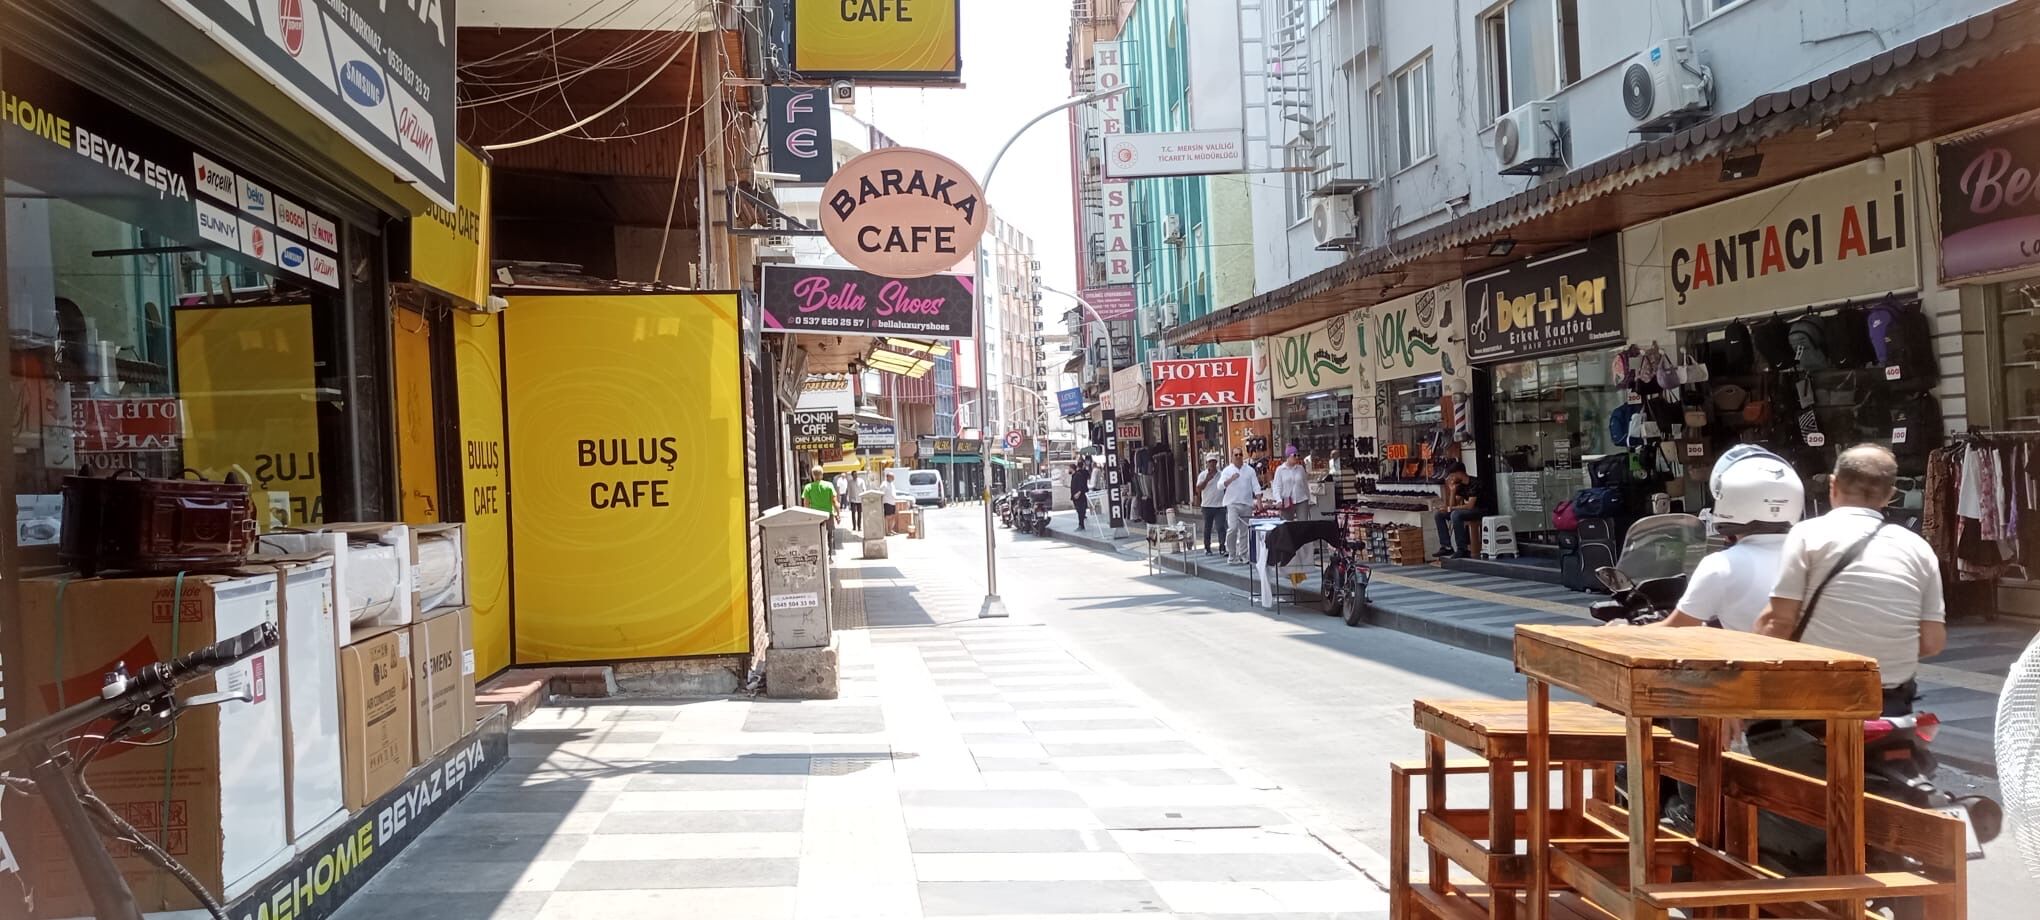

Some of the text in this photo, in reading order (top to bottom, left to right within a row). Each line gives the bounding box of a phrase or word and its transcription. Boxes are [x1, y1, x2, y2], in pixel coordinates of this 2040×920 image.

[841, 0, 913, 22] CAFE
[350, 8, 382, 55] KORKMAZ
[387, 48, 403, 75] 0533
[403, 64, 414, 86] 037
[415, 76, 423, 96] 33
[423, 84, 430, 102] 27
[346, 61, 381, 105] SAMSUNG
[1, 90, 189, 202] HOME BEYAZ EŞYA
[399, 107, 433, 163] arzum
[1177, 144, 1203, 152] MERSİN
[1206, 142, 1234, 151] VALİLİĞİ
[1158, 151, 1239, 162] TİCARET İL MÜDÜRLÜĞÜ
[206, 171, 233, 195] arçelik
[246, 183, 264, 206] beko
[829, 169, 978, 225] BARAKA
[200, 213, 235, 238] SUNNY
[285, 208, 305, 230] BOSCH
[458, 205, 480, 245] CAFE
[317, 227, 334, 245] ALTUS
[857, 225, 956, 254] CAFE
[1108, 190, 1129, 275] STAR
[1671, 179, 1906, 305] ÇANTACI ALİ
[793, 276, 946, 317] Bella Shoes
[795, 317, 801, 325] 0
[802, 317, 820, 326] 537
[821, 317, 839, 327] 650
[852, 319, 864, 327] 57
[1510, 328, 1539, 345] Erkek
[1547, 336, 1575, 348] SALON
[1157, 362, 1239, 380] HOTEL
[1160, 390, 1240, 407] STAR
[793, 412, 834, 424] KONAK
[802, 423, 827, 435] CAFE
[468, 440, 499, 477] BULUŞ
[578, 437, 678, 472] BULUŞ
[1388, 445, 1405, 458] 500
[1105, 419, 1121, 519] BERBER
[473, 484, 498, 517] CAFE
[590, 479, 670, 509] CAFE
[380, 663, 388, 680] LG
[378, 768, 442, 847] BEYAZ
[446, 739, 485, 791] EŞYA
